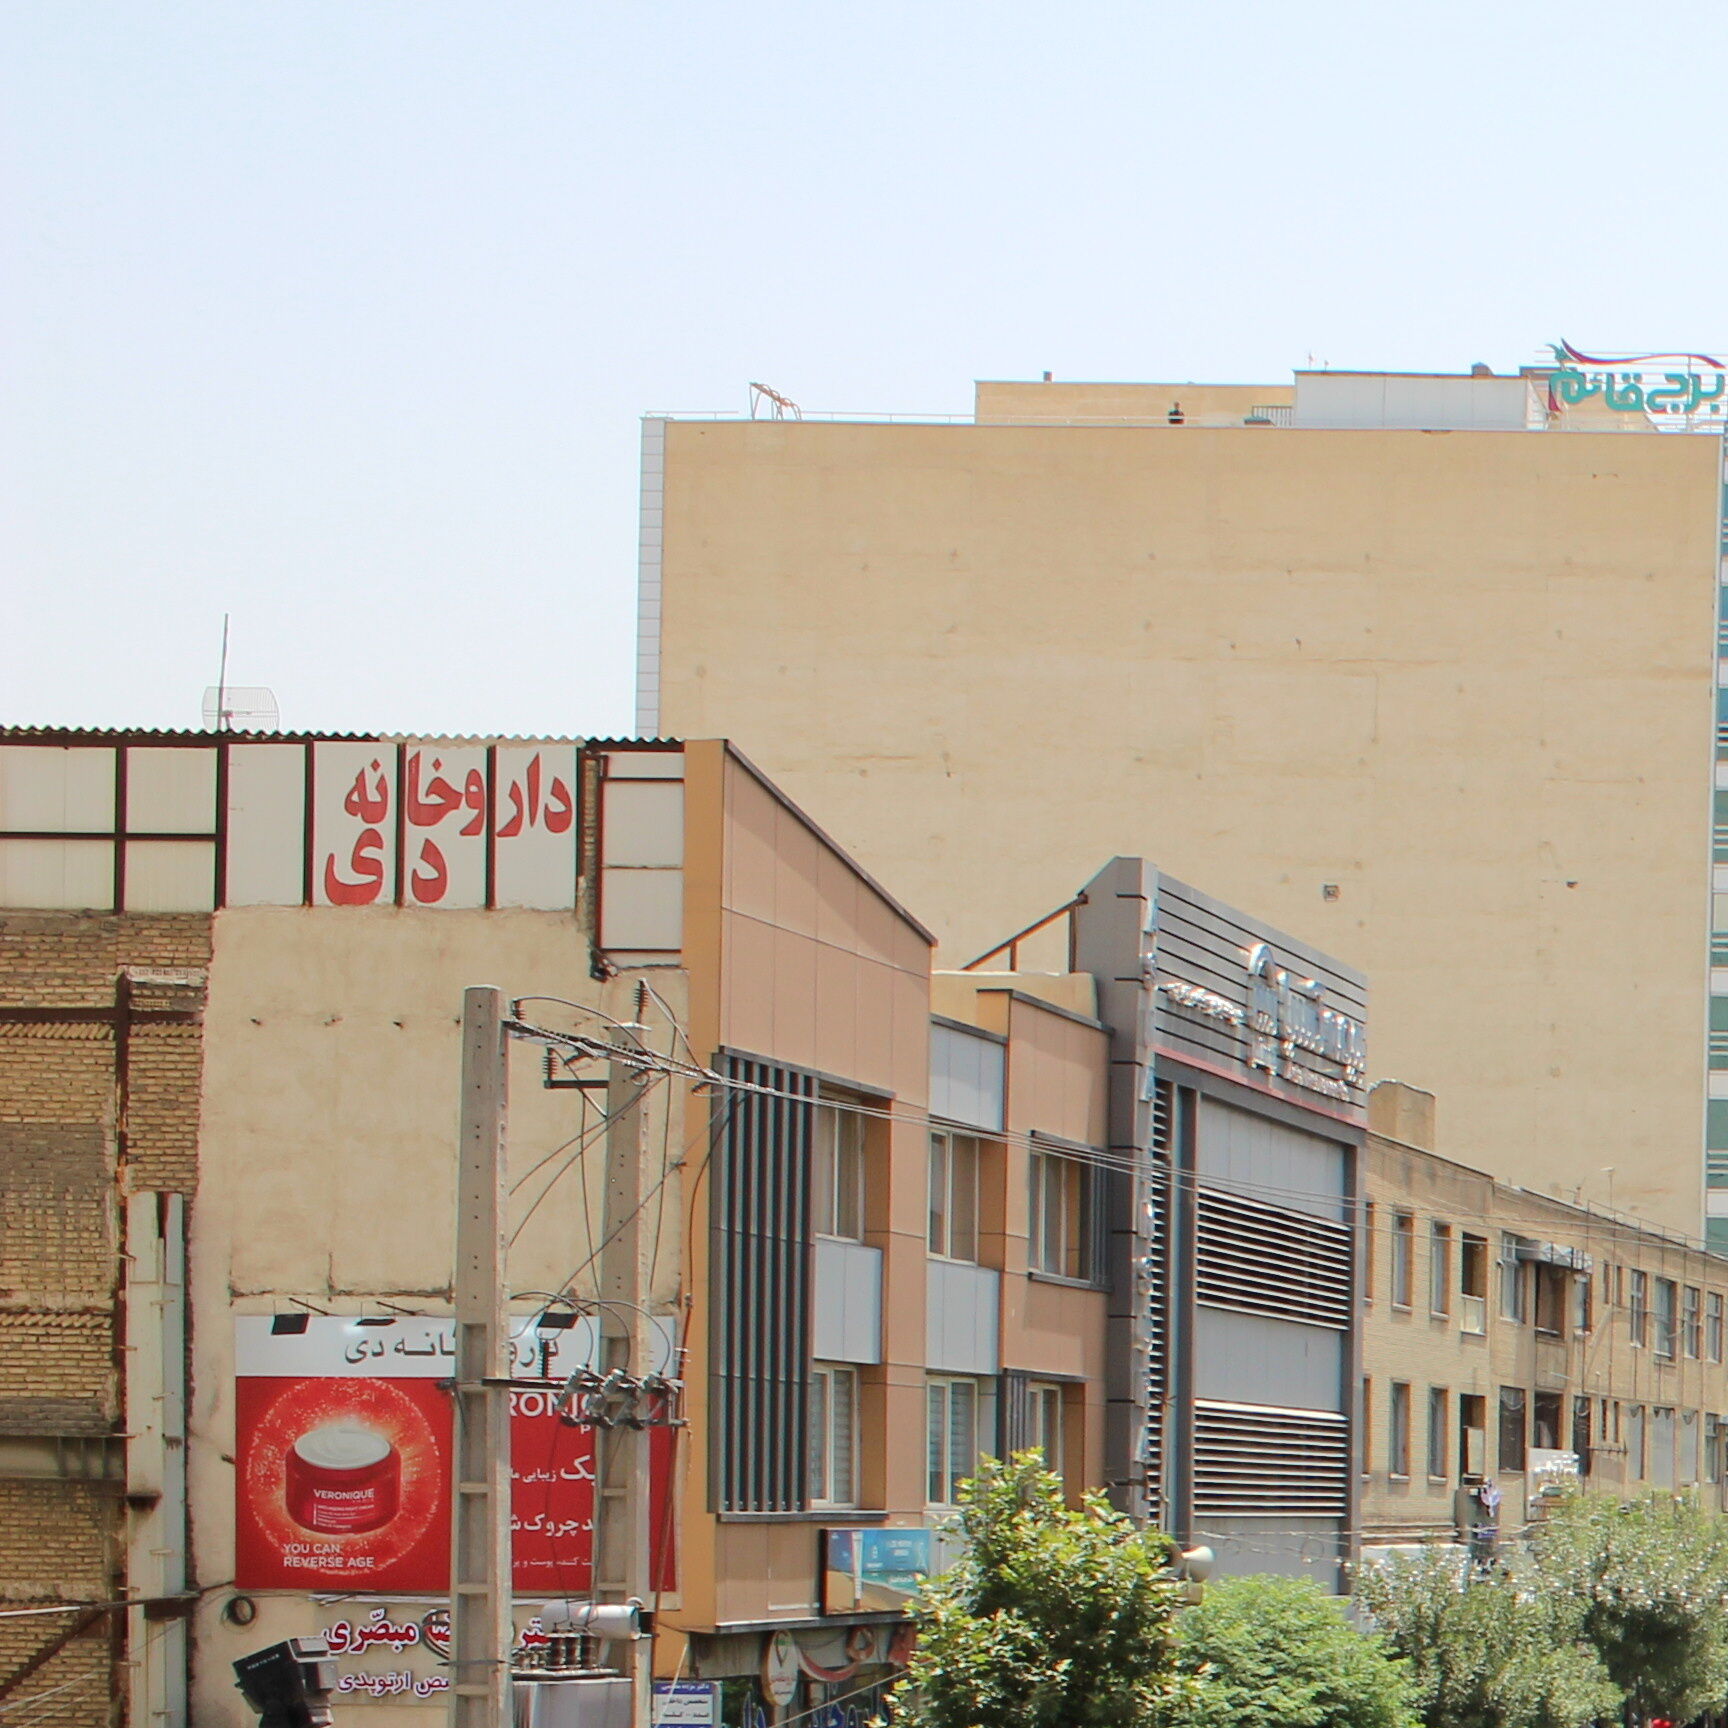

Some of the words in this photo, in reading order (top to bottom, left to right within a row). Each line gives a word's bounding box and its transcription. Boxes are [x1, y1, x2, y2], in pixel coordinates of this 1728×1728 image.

[1646, 372, 1726, 415] برج
[344, 752, 574, 837] داروخانه
[325, 827, 448, 905] دی
[344, 1339, 385, 1364] دی
[313, 1487, 375, 1500] VERONIQUE
[283, 1543, 310, 1554] YOU
[313, 1543, 341, 1554] CAN
[283, 1556, 344, 1568] REVERSE
[346, 1556, 375, 1568] AGE
[338, 1672, 410, 1698] ارتوپدی
